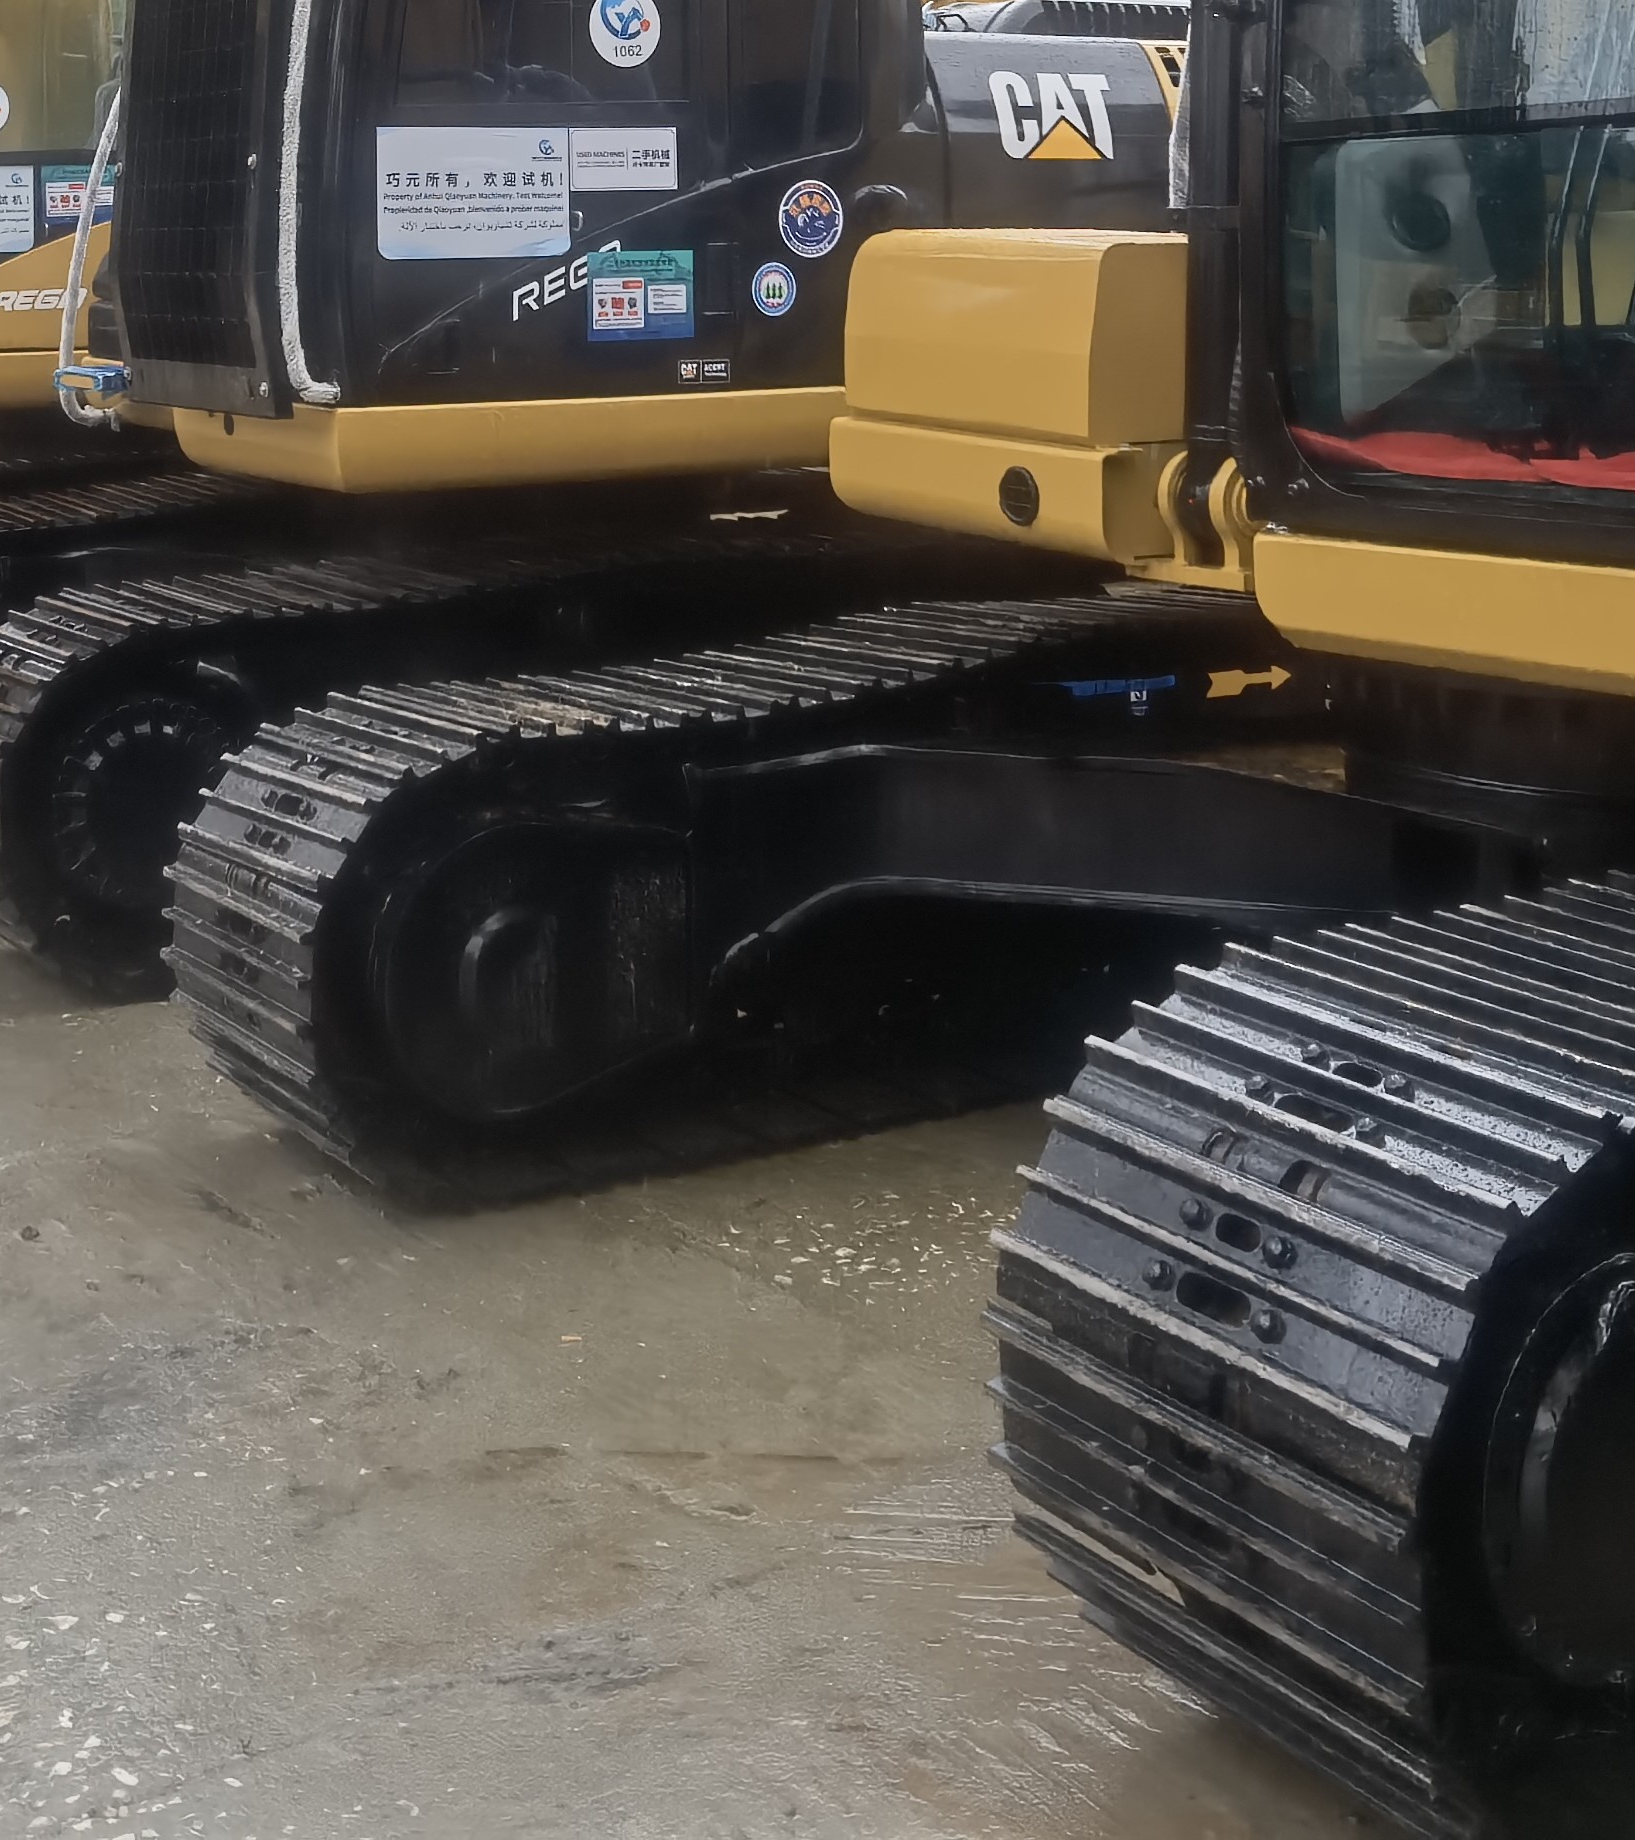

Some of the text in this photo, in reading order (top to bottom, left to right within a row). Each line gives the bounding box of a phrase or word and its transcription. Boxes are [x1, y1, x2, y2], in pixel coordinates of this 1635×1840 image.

[614, 44, 644, 58] 1062
[988, 70, 1114, 160] CAT
[513, 239, 622, 321] REG
